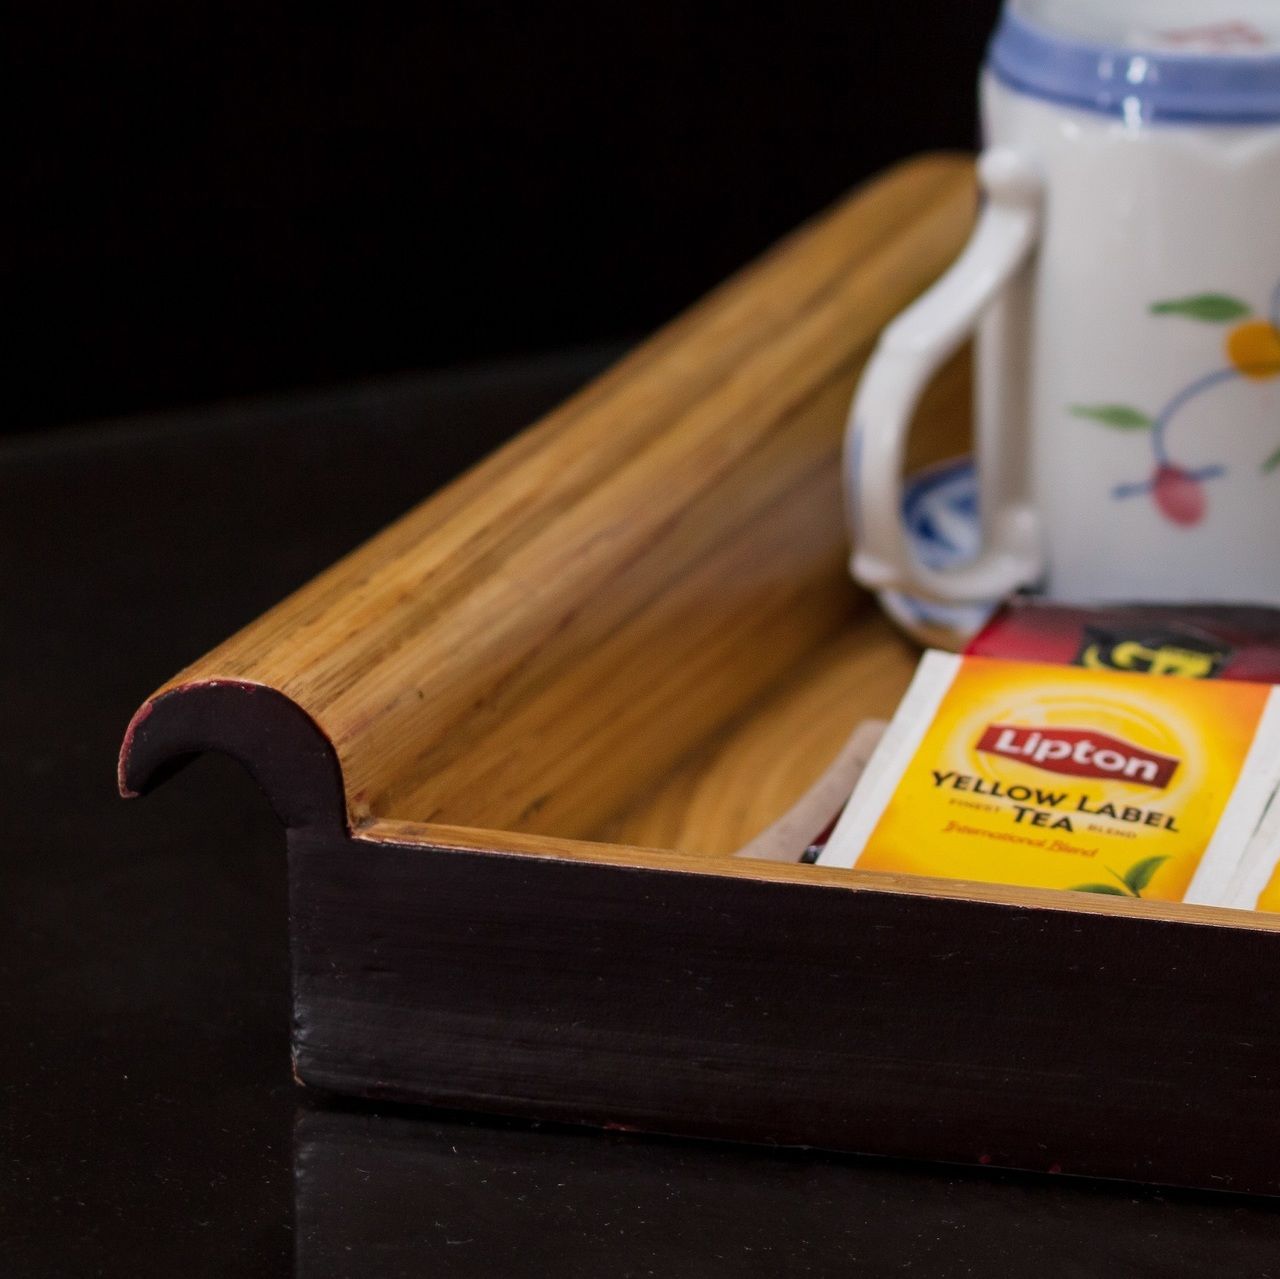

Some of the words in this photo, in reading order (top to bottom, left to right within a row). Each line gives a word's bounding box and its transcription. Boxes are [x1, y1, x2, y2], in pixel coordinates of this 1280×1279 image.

[995, 728, 1160, 783] Lipton
[931, 771, 1069, 807] YELLOW
[1077, 795, 1181, 833] LABEL
[1012, 805, 1075, 833] TEA
[941, 820, 1046, 848] International
[1046, 839, 1100, 858] Blend
